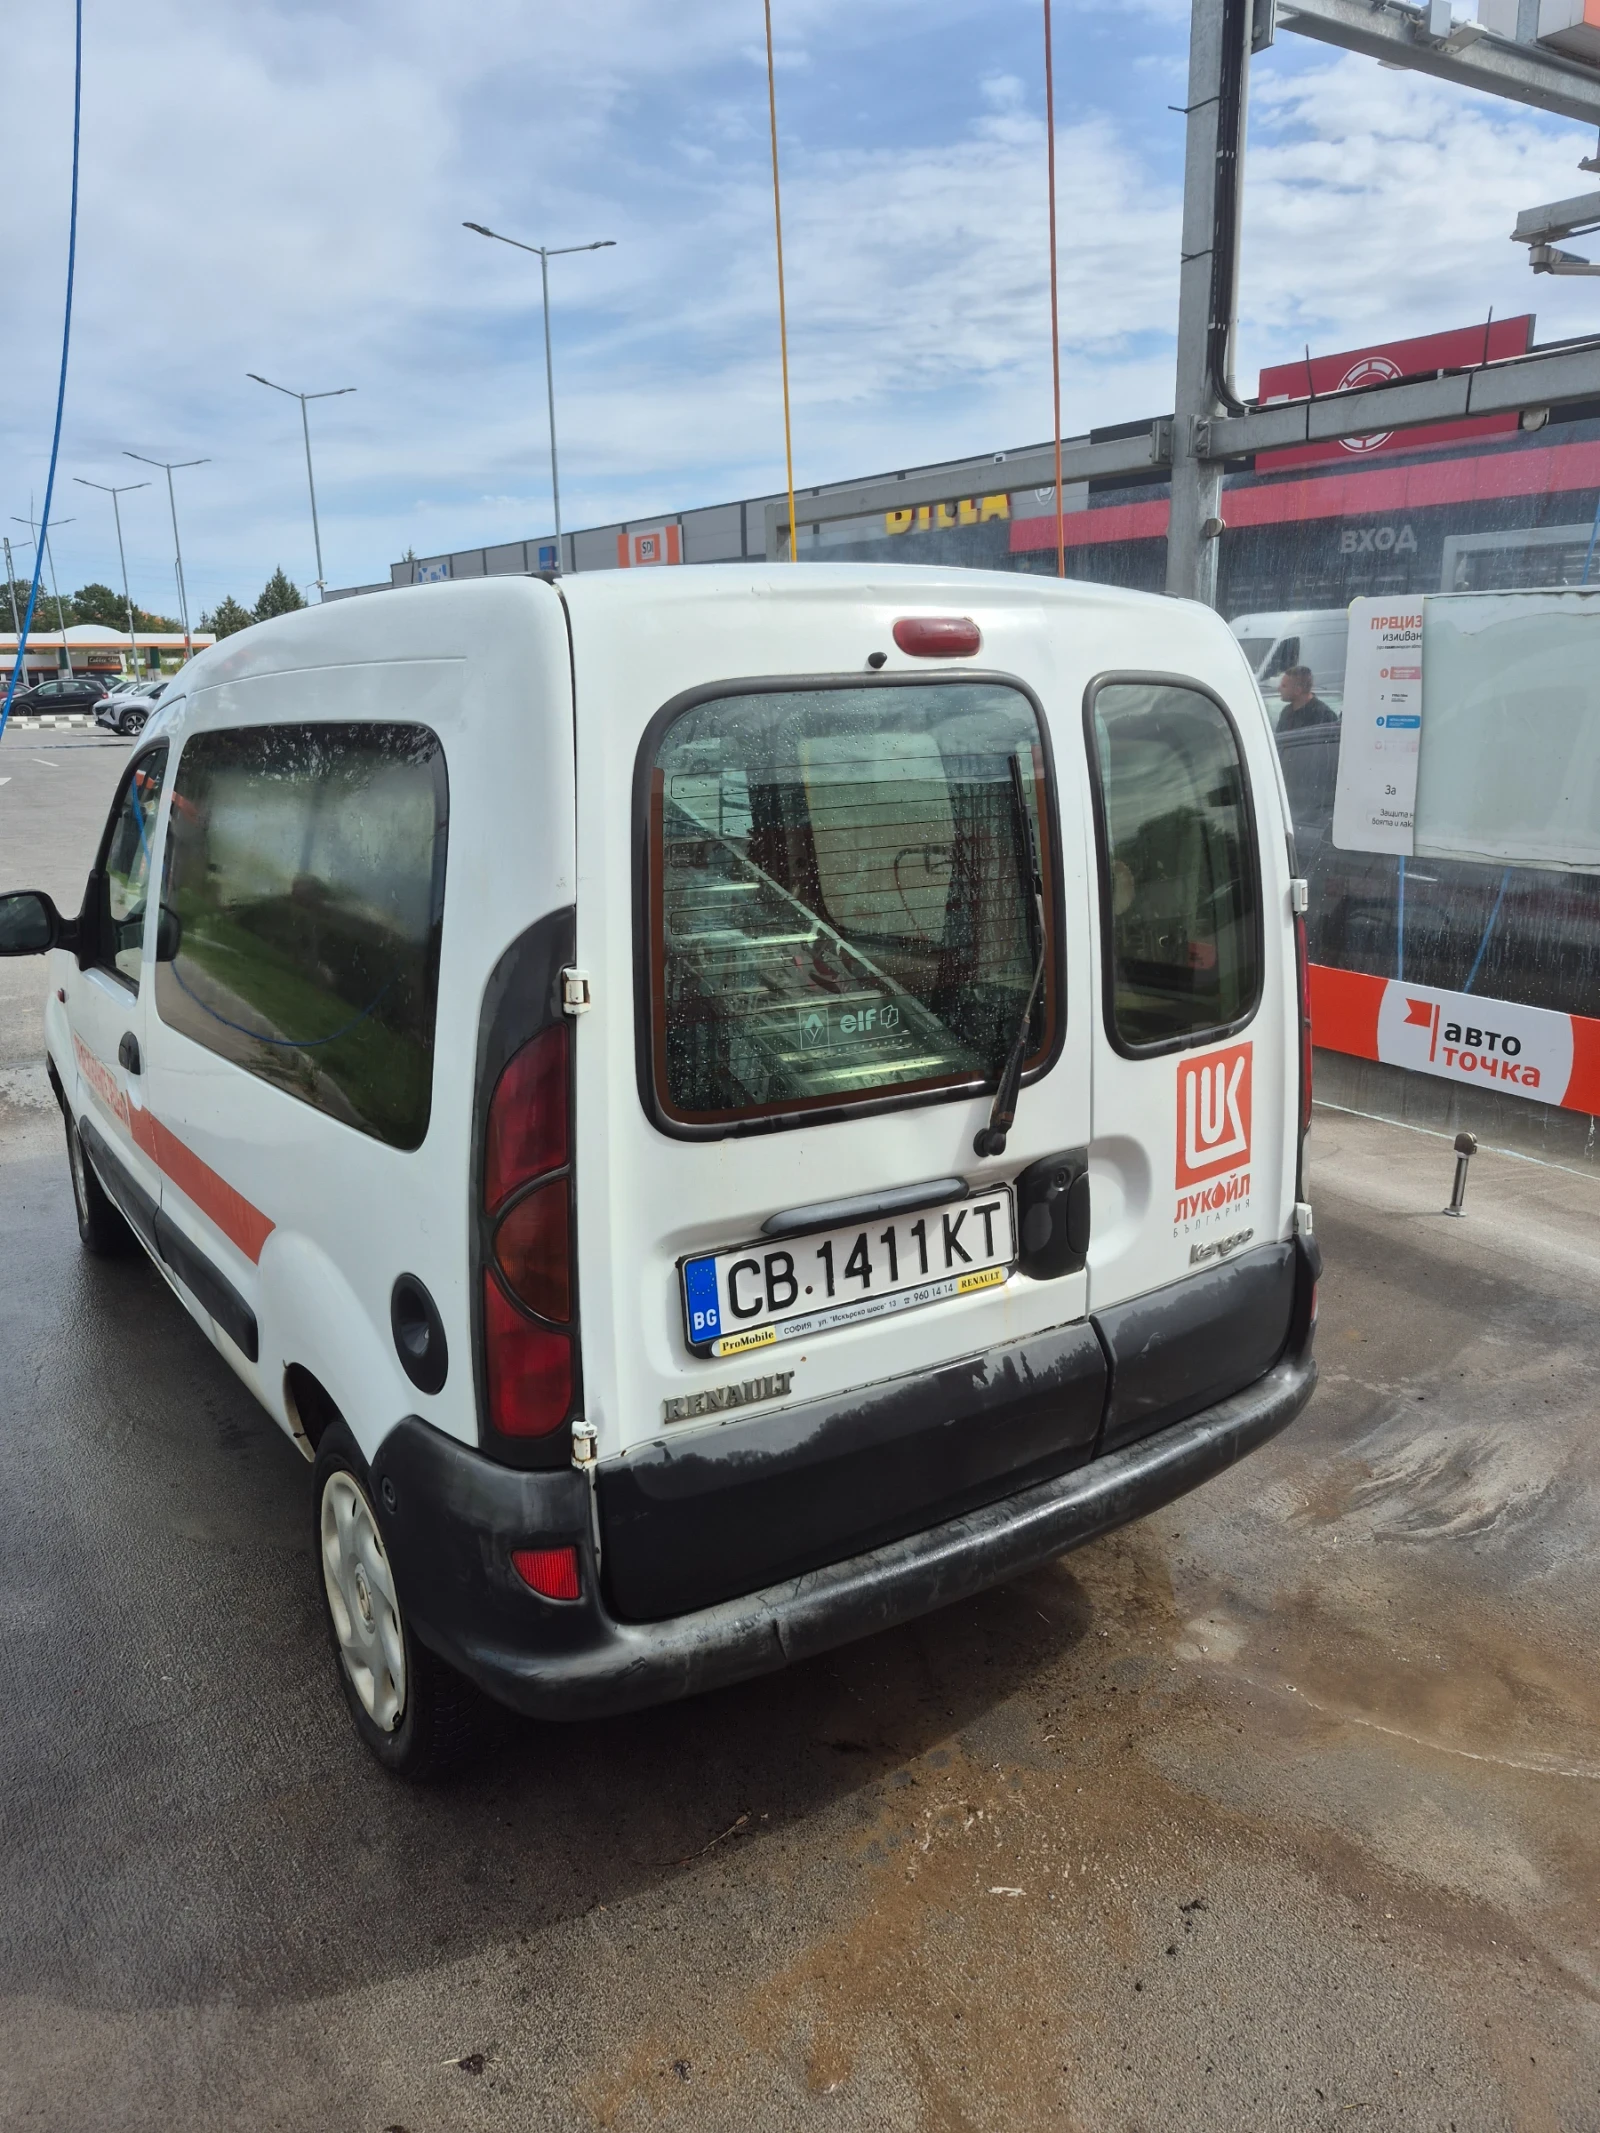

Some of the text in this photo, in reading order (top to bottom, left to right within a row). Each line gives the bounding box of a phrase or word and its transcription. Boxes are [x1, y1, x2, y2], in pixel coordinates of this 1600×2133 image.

[1340, 525, 1417, 554] ВХОД
[1384, 784, 1397, 796] За
[1380, 808, 1408, 819] Защита
[840, 1009, 877, 1033] elf
[1444, 1023, 1521, 1056] авто
[1443, 1047, 1541, 1088] точка
[1173, 1199, 1250, 1238] БЪЛГАРИЯ
[1189, 1227, 1254, 1264] Kangoo
[961, 1271, 1000, 1288] RENAULT
[693, 1309, 717, 1331] BG
[784, 1321, 812, 1335] СОФИЯ
[818, 1318, 828, 1328] ул.
[889, 1300, 897, 1308] 13
[913, 1291, 928, 1302] 960
[932, 1287, 941, 1297] 14
[945, 1284, 954, 1293] 14
[722, 1331, 774, 1352] ProMobile
[663, 1371, 795, 1424] RENAULT
